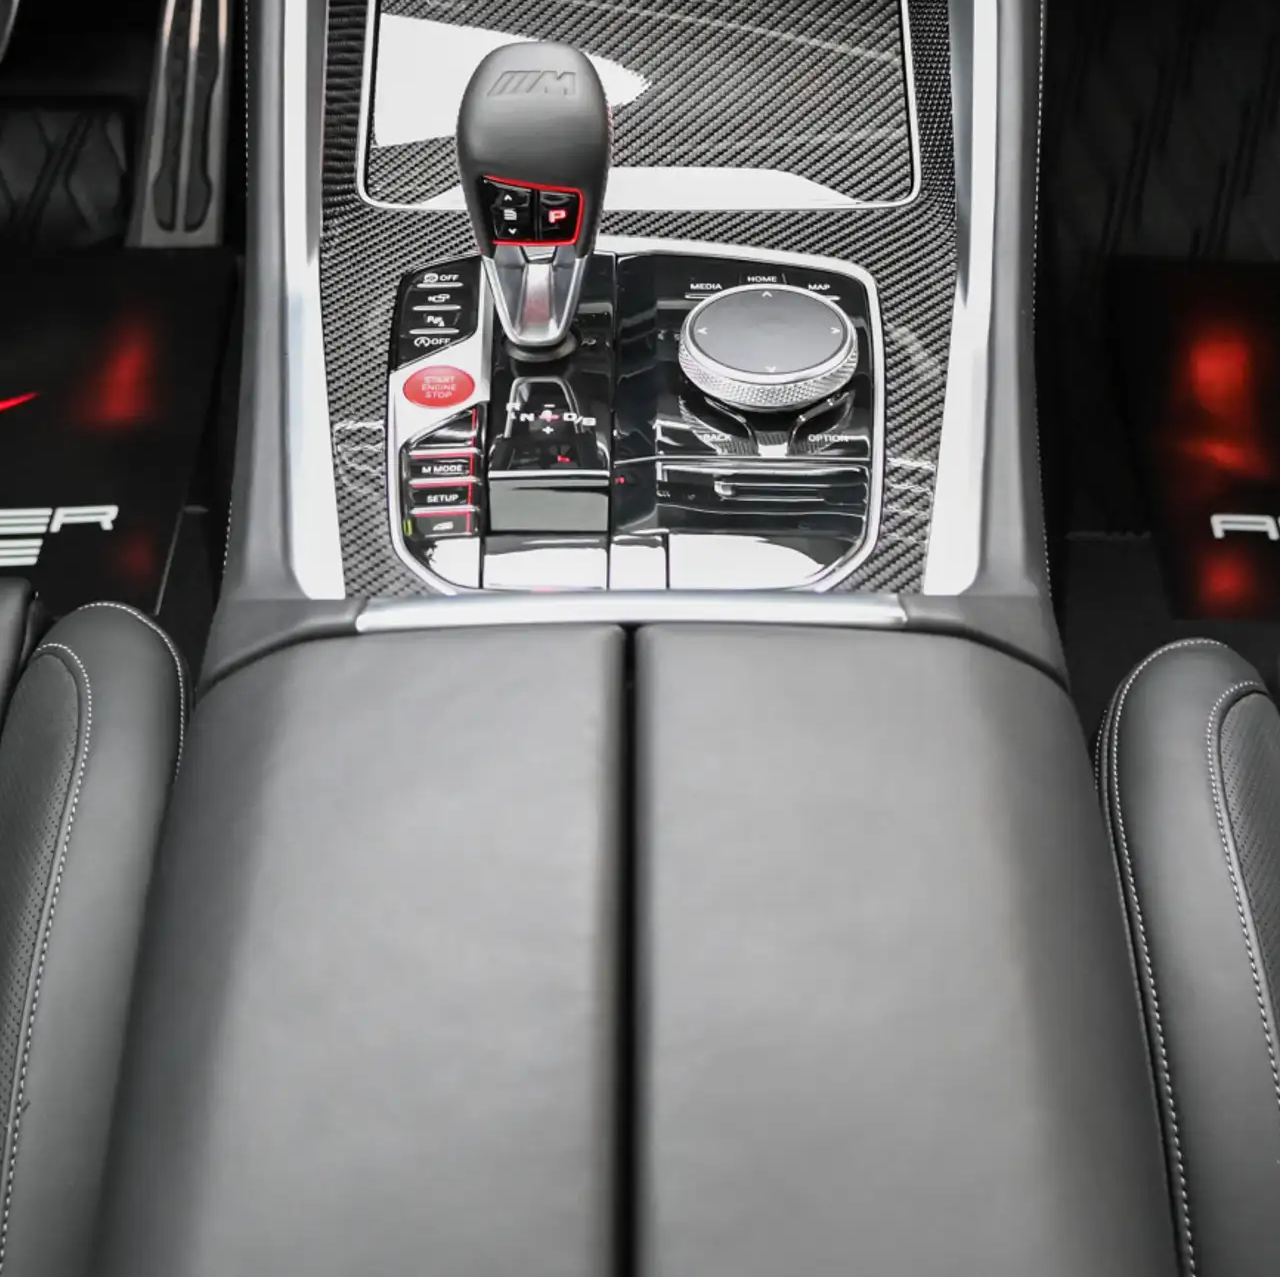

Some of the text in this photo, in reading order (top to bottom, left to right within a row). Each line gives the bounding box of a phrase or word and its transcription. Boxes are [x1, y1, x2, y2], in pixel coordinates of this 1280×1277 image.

[548, 209, 567, 224] P
[440, 274, 459, 282] OFF
[747, 275, 777, 283] HOME
[808, 283, 830, 291] MAP
[431, 337, 451, 345] OFF
[425, 391, 453, 399] STOP
[520, 412, 535, 422] N
[703, 434, 732, 442] BACK
[808, 434, 849, 442] OPTION
[421, 464, 463, 474] M MODE
[427, 494, 459, 503] SETUP
